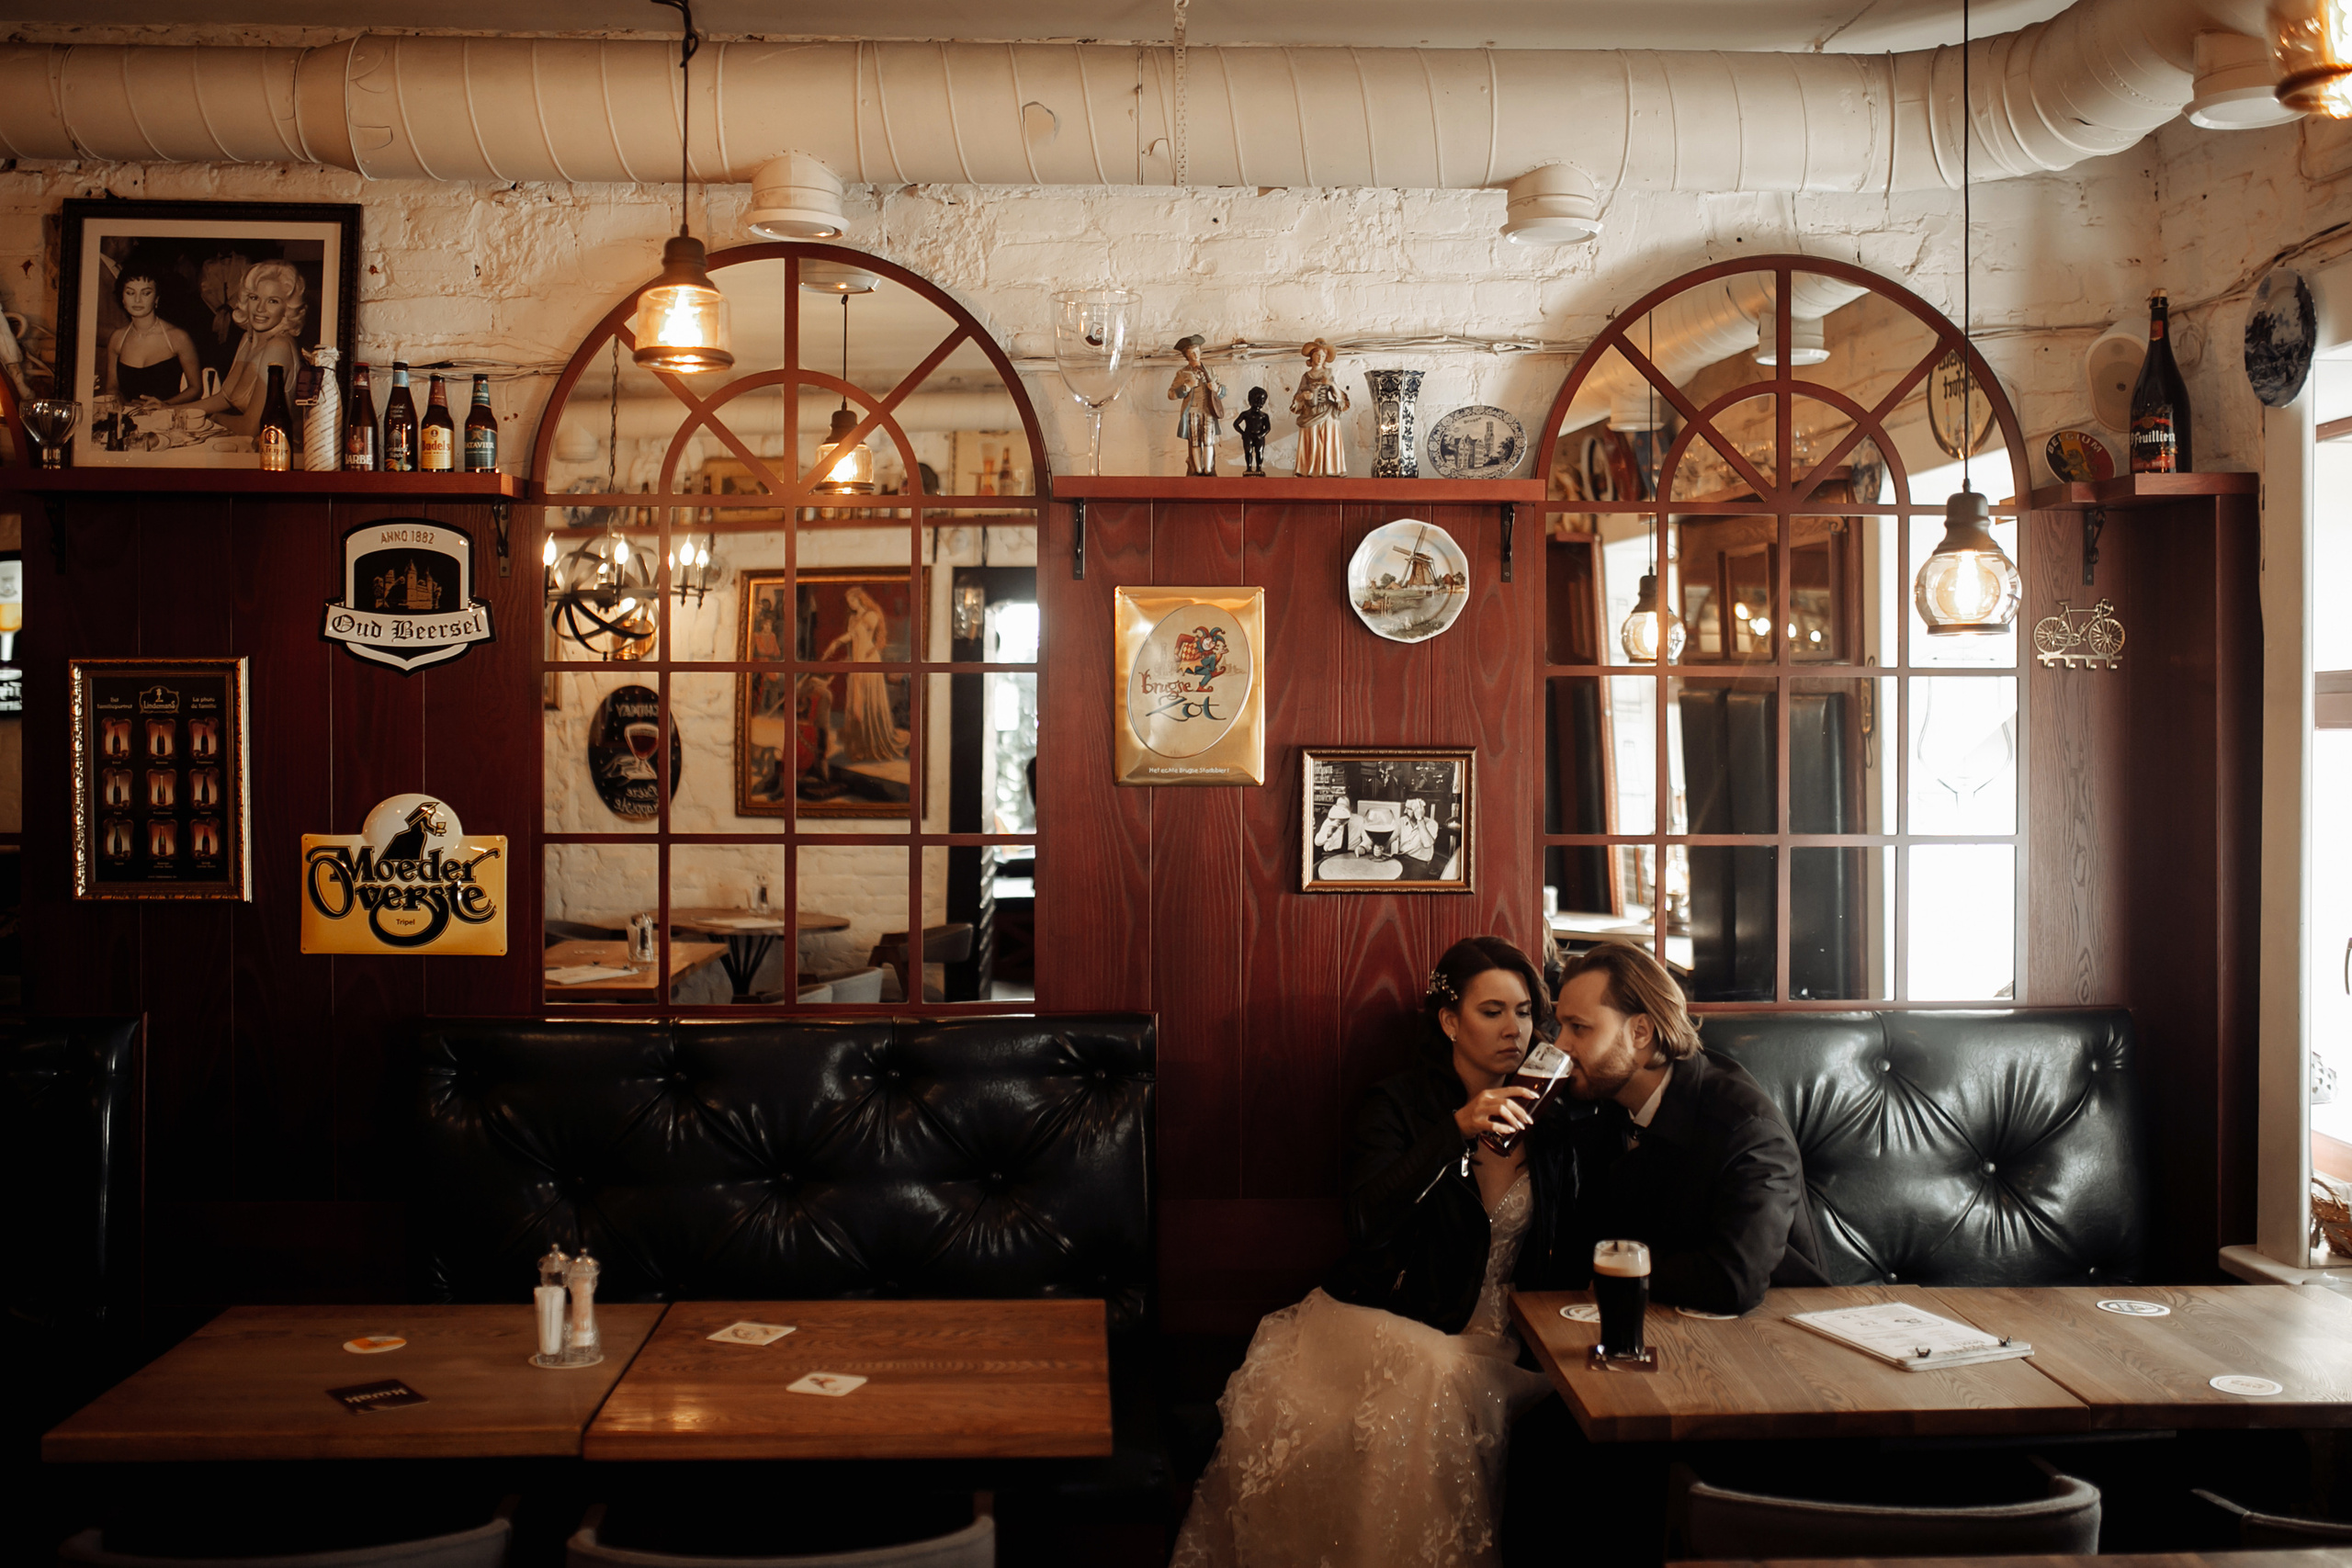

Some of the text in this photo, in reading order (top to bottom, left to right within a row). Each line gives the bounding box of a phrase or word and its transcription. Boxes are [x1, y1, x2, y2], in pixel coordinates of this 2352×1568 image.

[2047, 433, 2102, 455] BELGIUM
[380, 530, 435, 544] ANNO 1882
[332, 614, 482, 643] Oud Beersel
[1145, 695, 1227, 722] Zot
[1160, 766, 1179, 774] echte
[1180, 766, 1199, 775] Brugse
[305, 845, 500, 884] Moeder
[307, 854, 497, 948] Overste
[396, 919, 415, 927] Tripel
